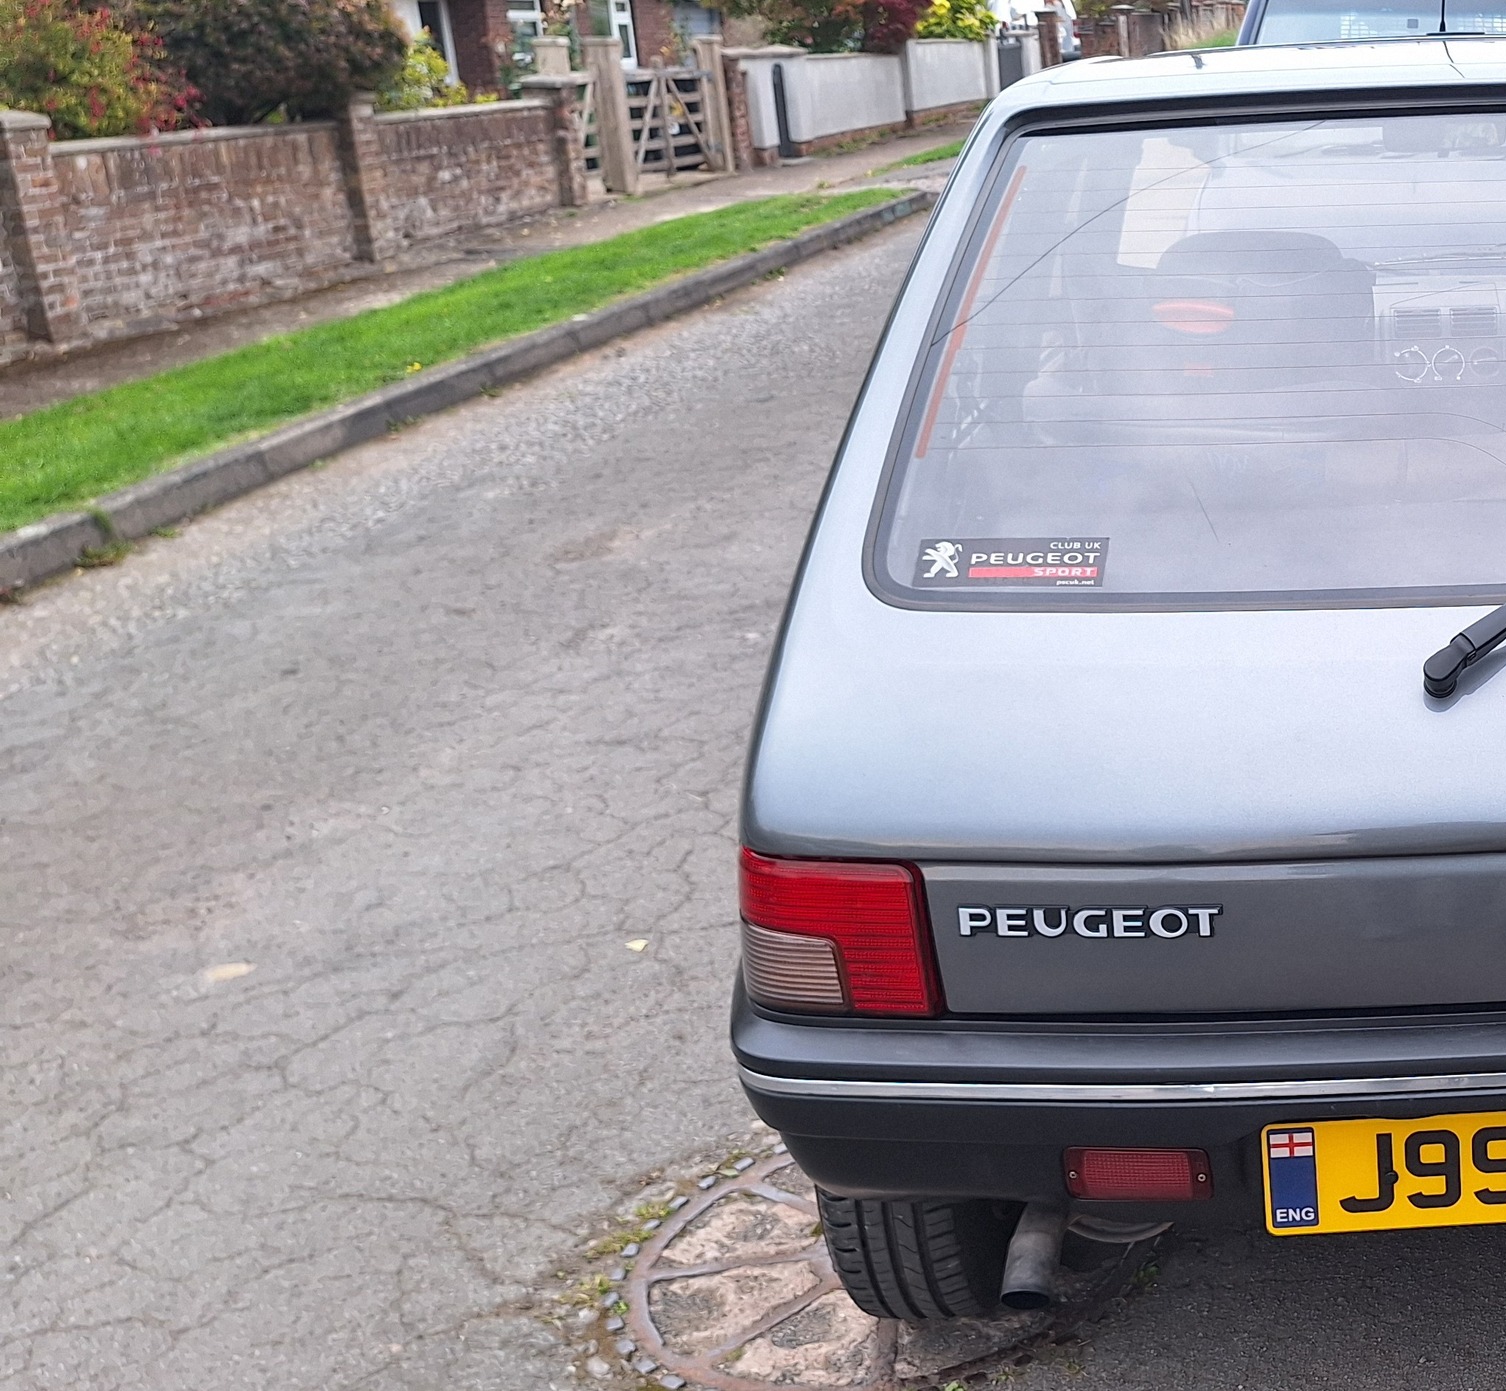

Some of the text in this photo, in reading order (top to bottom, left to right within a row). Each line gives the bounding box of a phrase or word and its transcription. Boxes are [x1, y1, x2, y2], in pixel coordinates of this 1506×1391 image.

[1050, 541, 1102, 550] CLUB UK
[970, 552, 1100, 565] PEUGEOT
[1033, 567, 1094, 577] SPORT
[957, 904, 1223, 938] PEUGEOT
[1275, 1207, 1315, 1222] ENG
